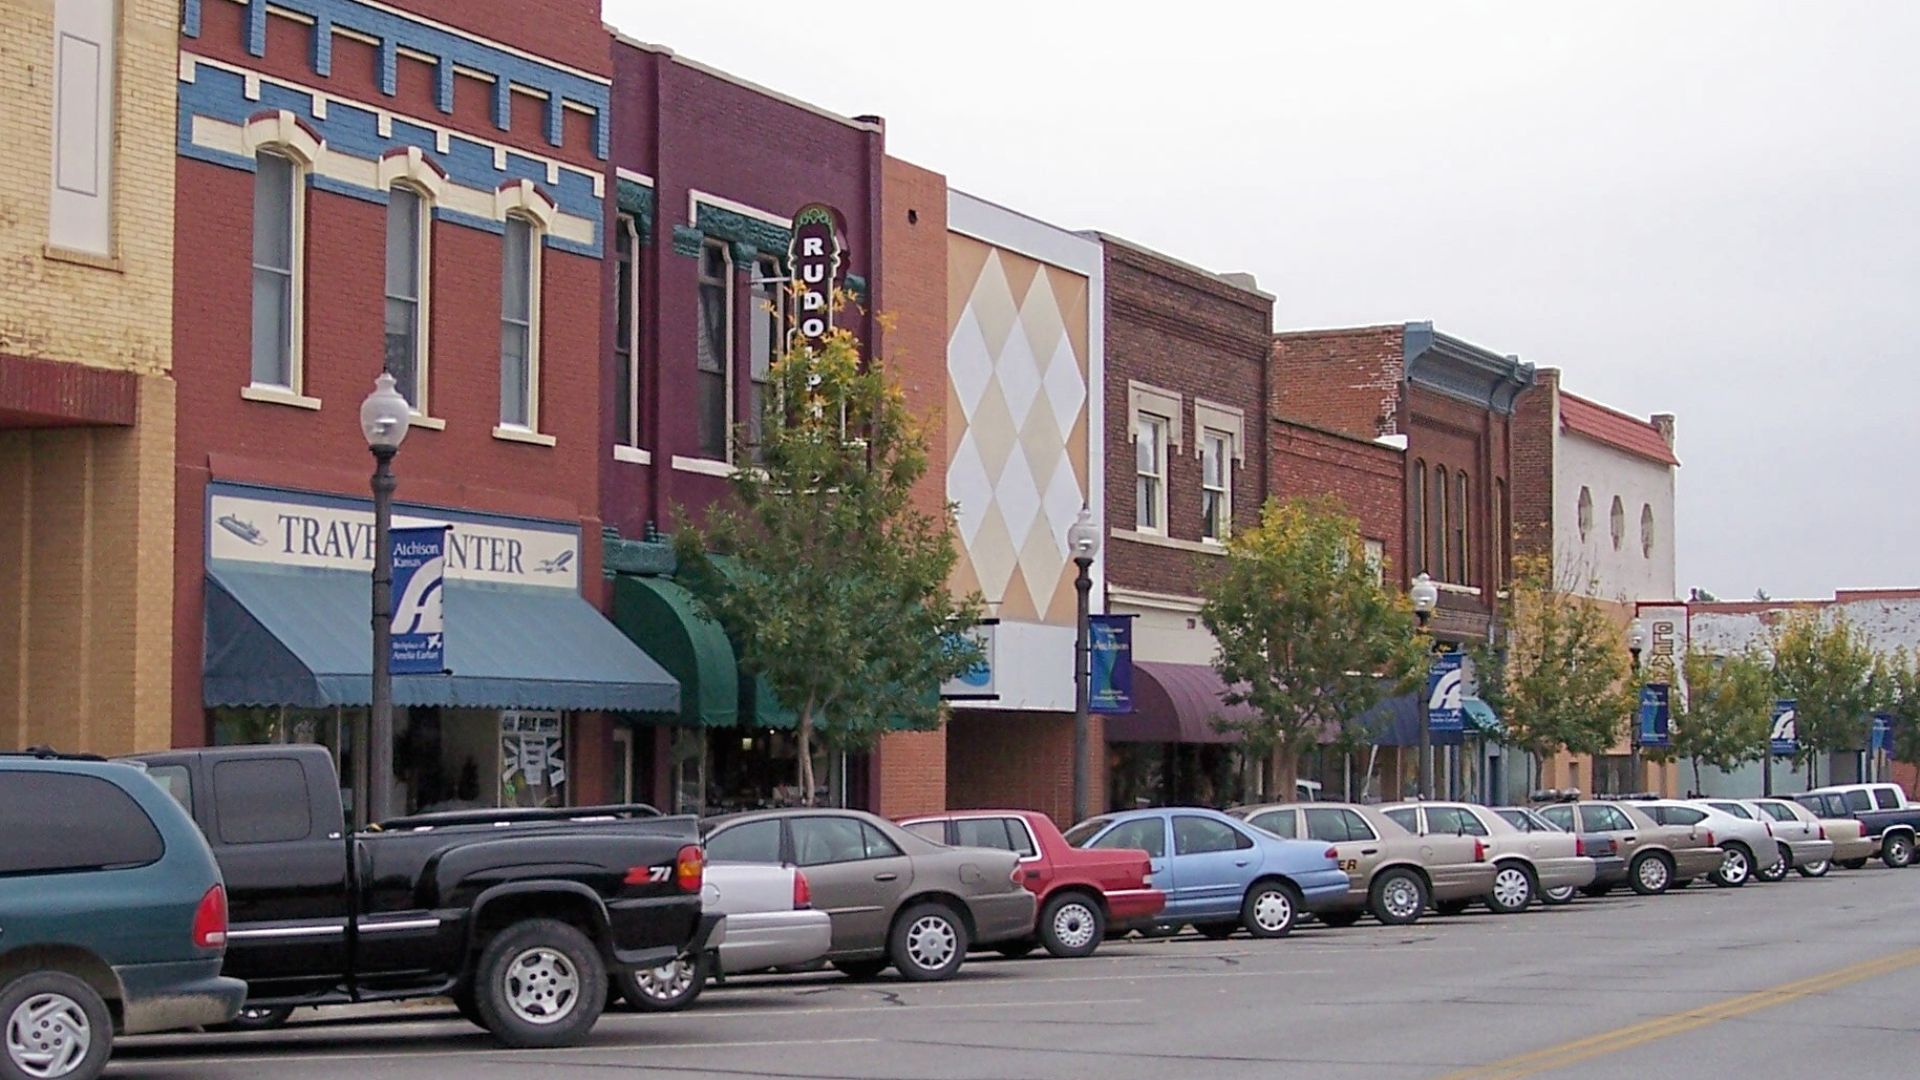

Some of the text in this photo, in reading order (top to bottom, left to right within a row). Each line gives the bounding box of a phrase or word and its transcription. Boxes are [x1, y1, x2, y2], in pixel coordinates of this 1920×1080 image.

[802, 236, 826, 419] RUDOLP
[277, 513, 525, 575] TRAVE NTER
[393, 541, 439, 556] Atchison
[1338, 859, 1357, 870] ER
